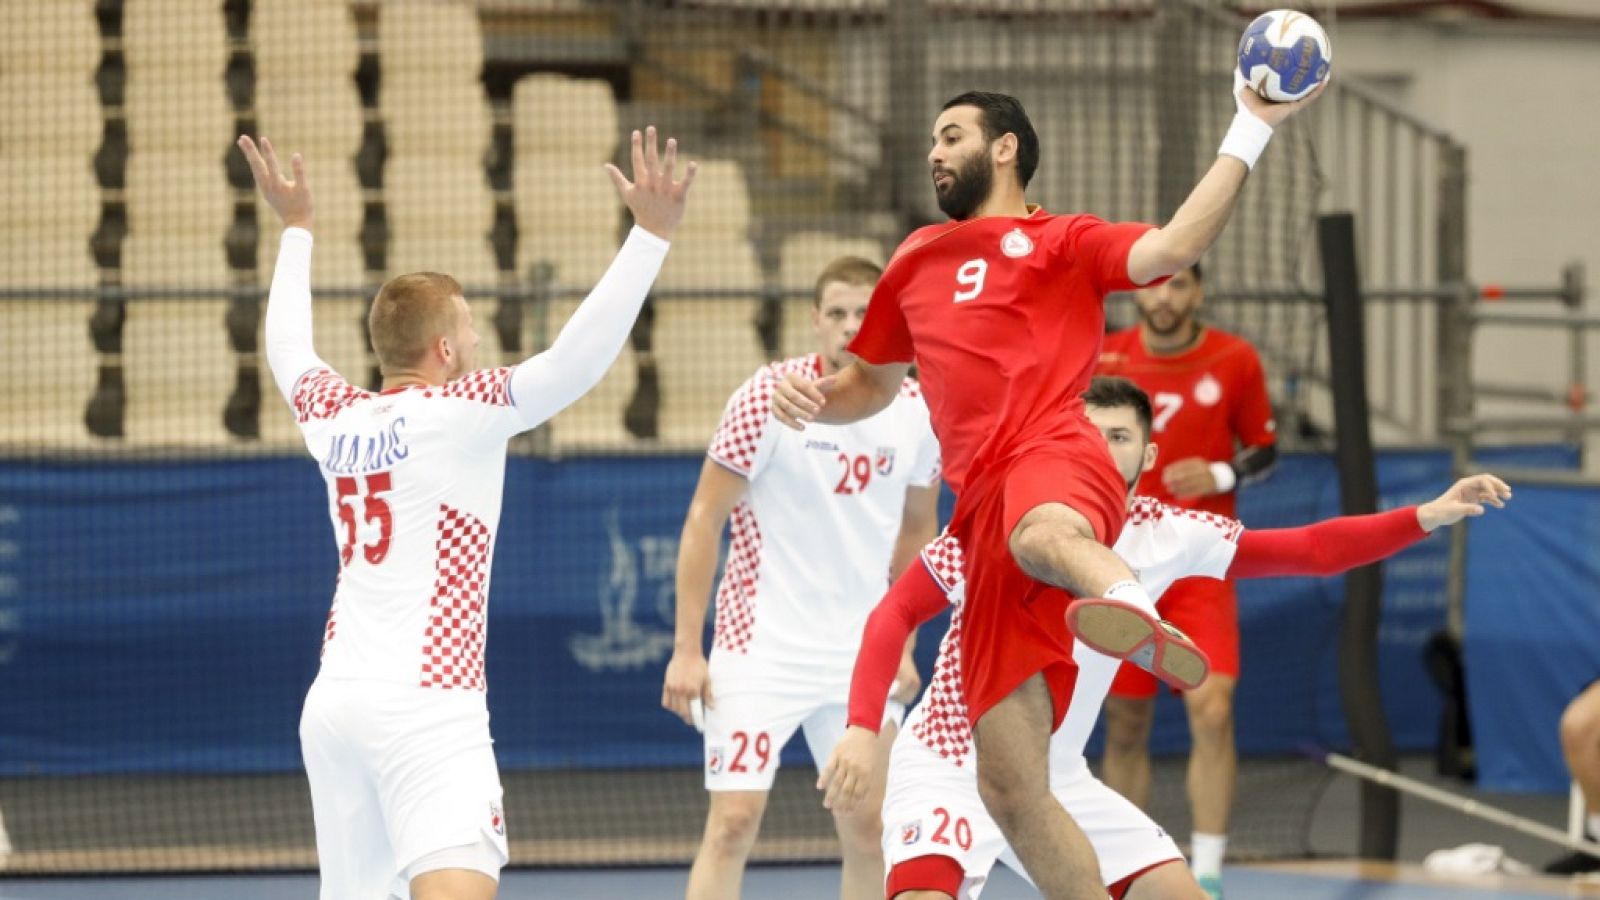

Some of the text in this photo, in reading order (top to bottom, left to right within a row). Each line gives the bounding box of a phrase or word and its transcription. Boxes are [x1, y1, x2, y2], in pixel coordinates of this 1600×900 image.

[953, 258, 988, 304] 9
[1152, 392, 1184, 433] 7
[834, 452, 872, 495] 29
[335, 471, 394, 567] 55
[728, 730, 771, 773] 29
[930, 807, 973, 852] 20
